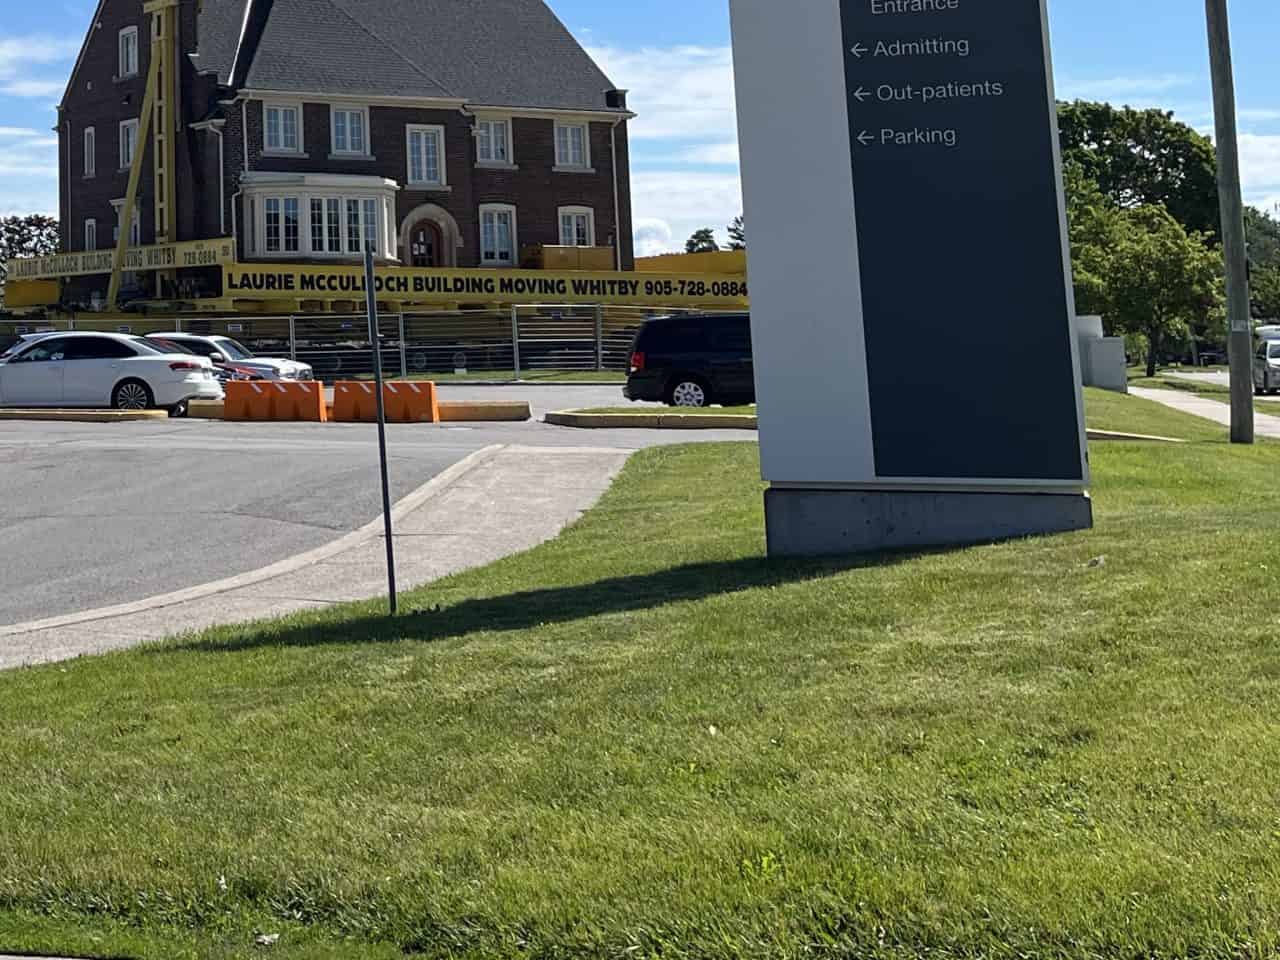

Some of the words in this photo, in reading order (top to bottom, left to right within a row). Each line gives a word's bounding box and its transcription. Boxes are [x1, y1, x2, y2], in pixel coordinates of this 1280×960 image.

[873, 36, 970, 57] Admitting
[876, 81, 1004, 103] Out-patients
[880, 127, 957, 147] Parking
[146, 245, 177, 266] WHITBY
[227, 273, 295, 290] LAURIE
[413, 276, 496, 294] BUILDING
[499, 277, 567, 295] MOVING
[571, 279, 639, 296] WHITBY
[644, 280, 748, 297] 905-728-0884
